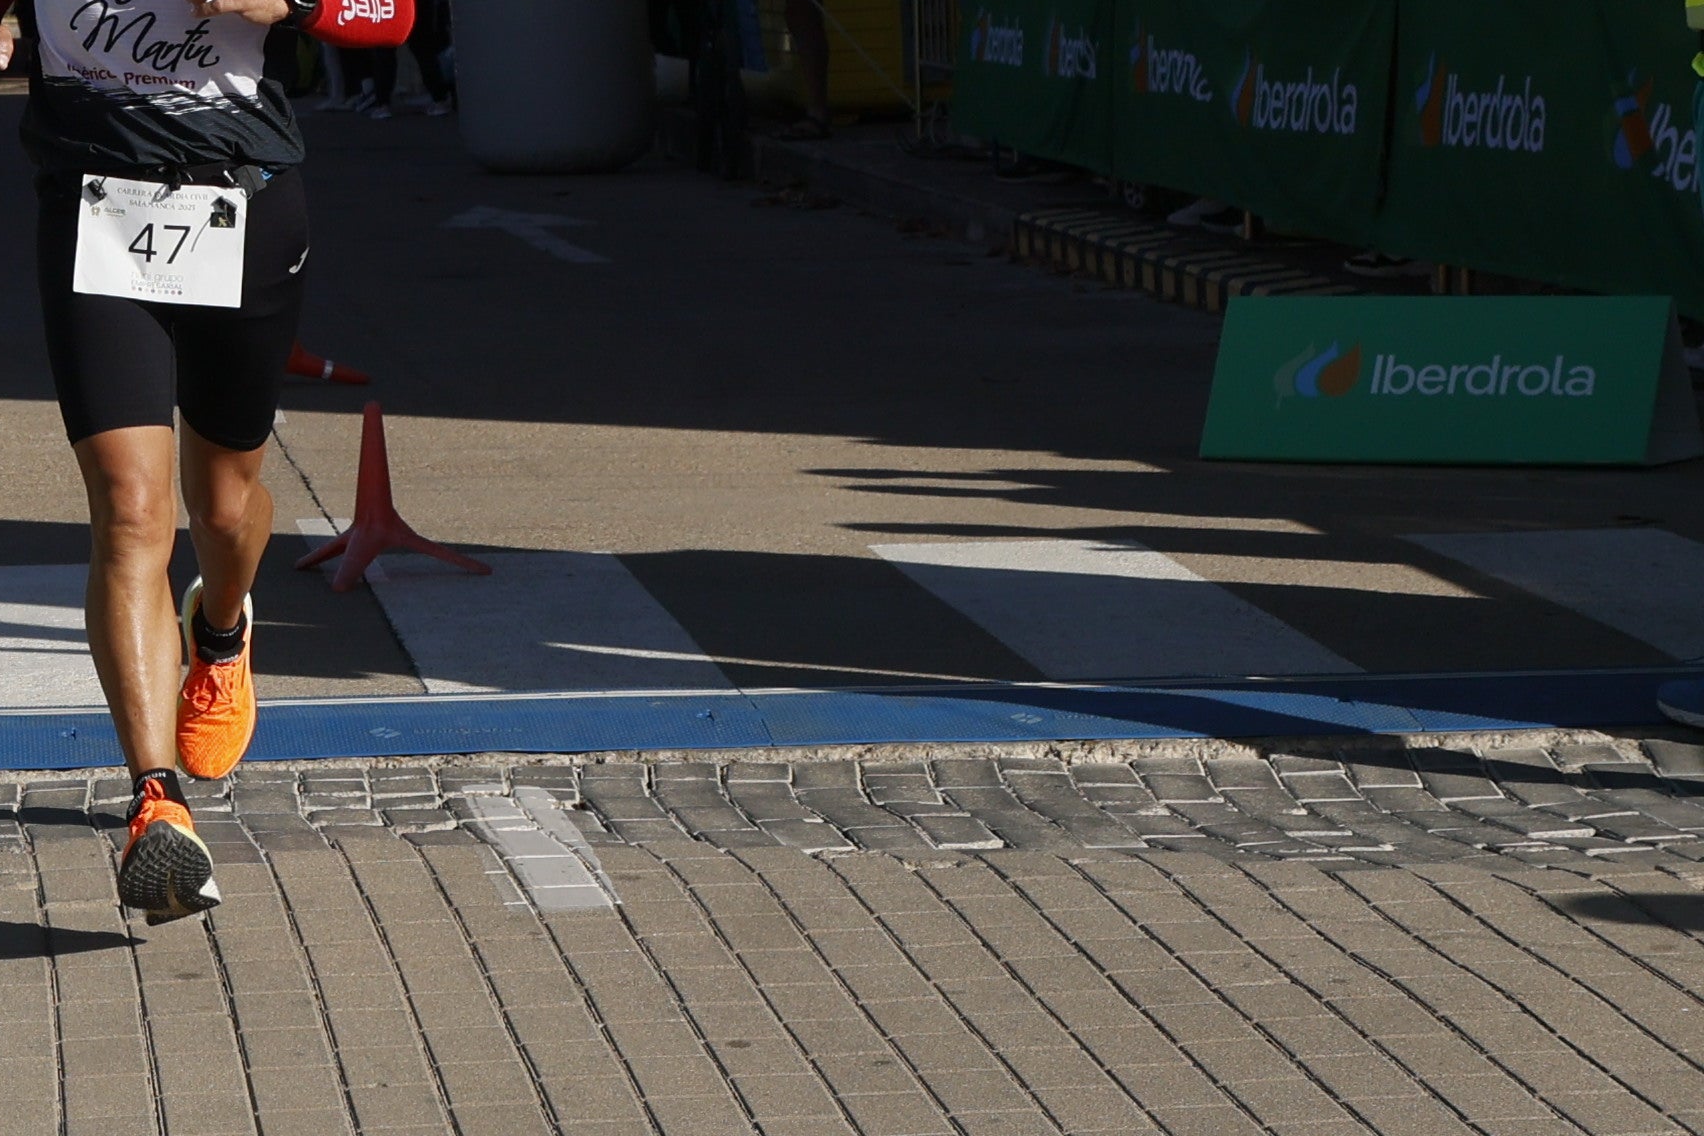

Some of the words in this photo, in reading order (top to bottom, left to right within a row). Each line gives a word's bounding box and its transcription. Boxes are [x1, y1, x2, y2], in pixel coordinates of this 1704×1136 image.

[70, 0, 220, 72] Martín
[1252, 63, 1358, 134] Iberdrola
[1442, 73, 1547, 152] Iberdrola
[117, 187, 153, 198] CARRERA
[129, 199, 176, 211] SALAMANCA
[128, 223, 191, 264] 47
[1369, 353, 1597, 397] Iberdrola
